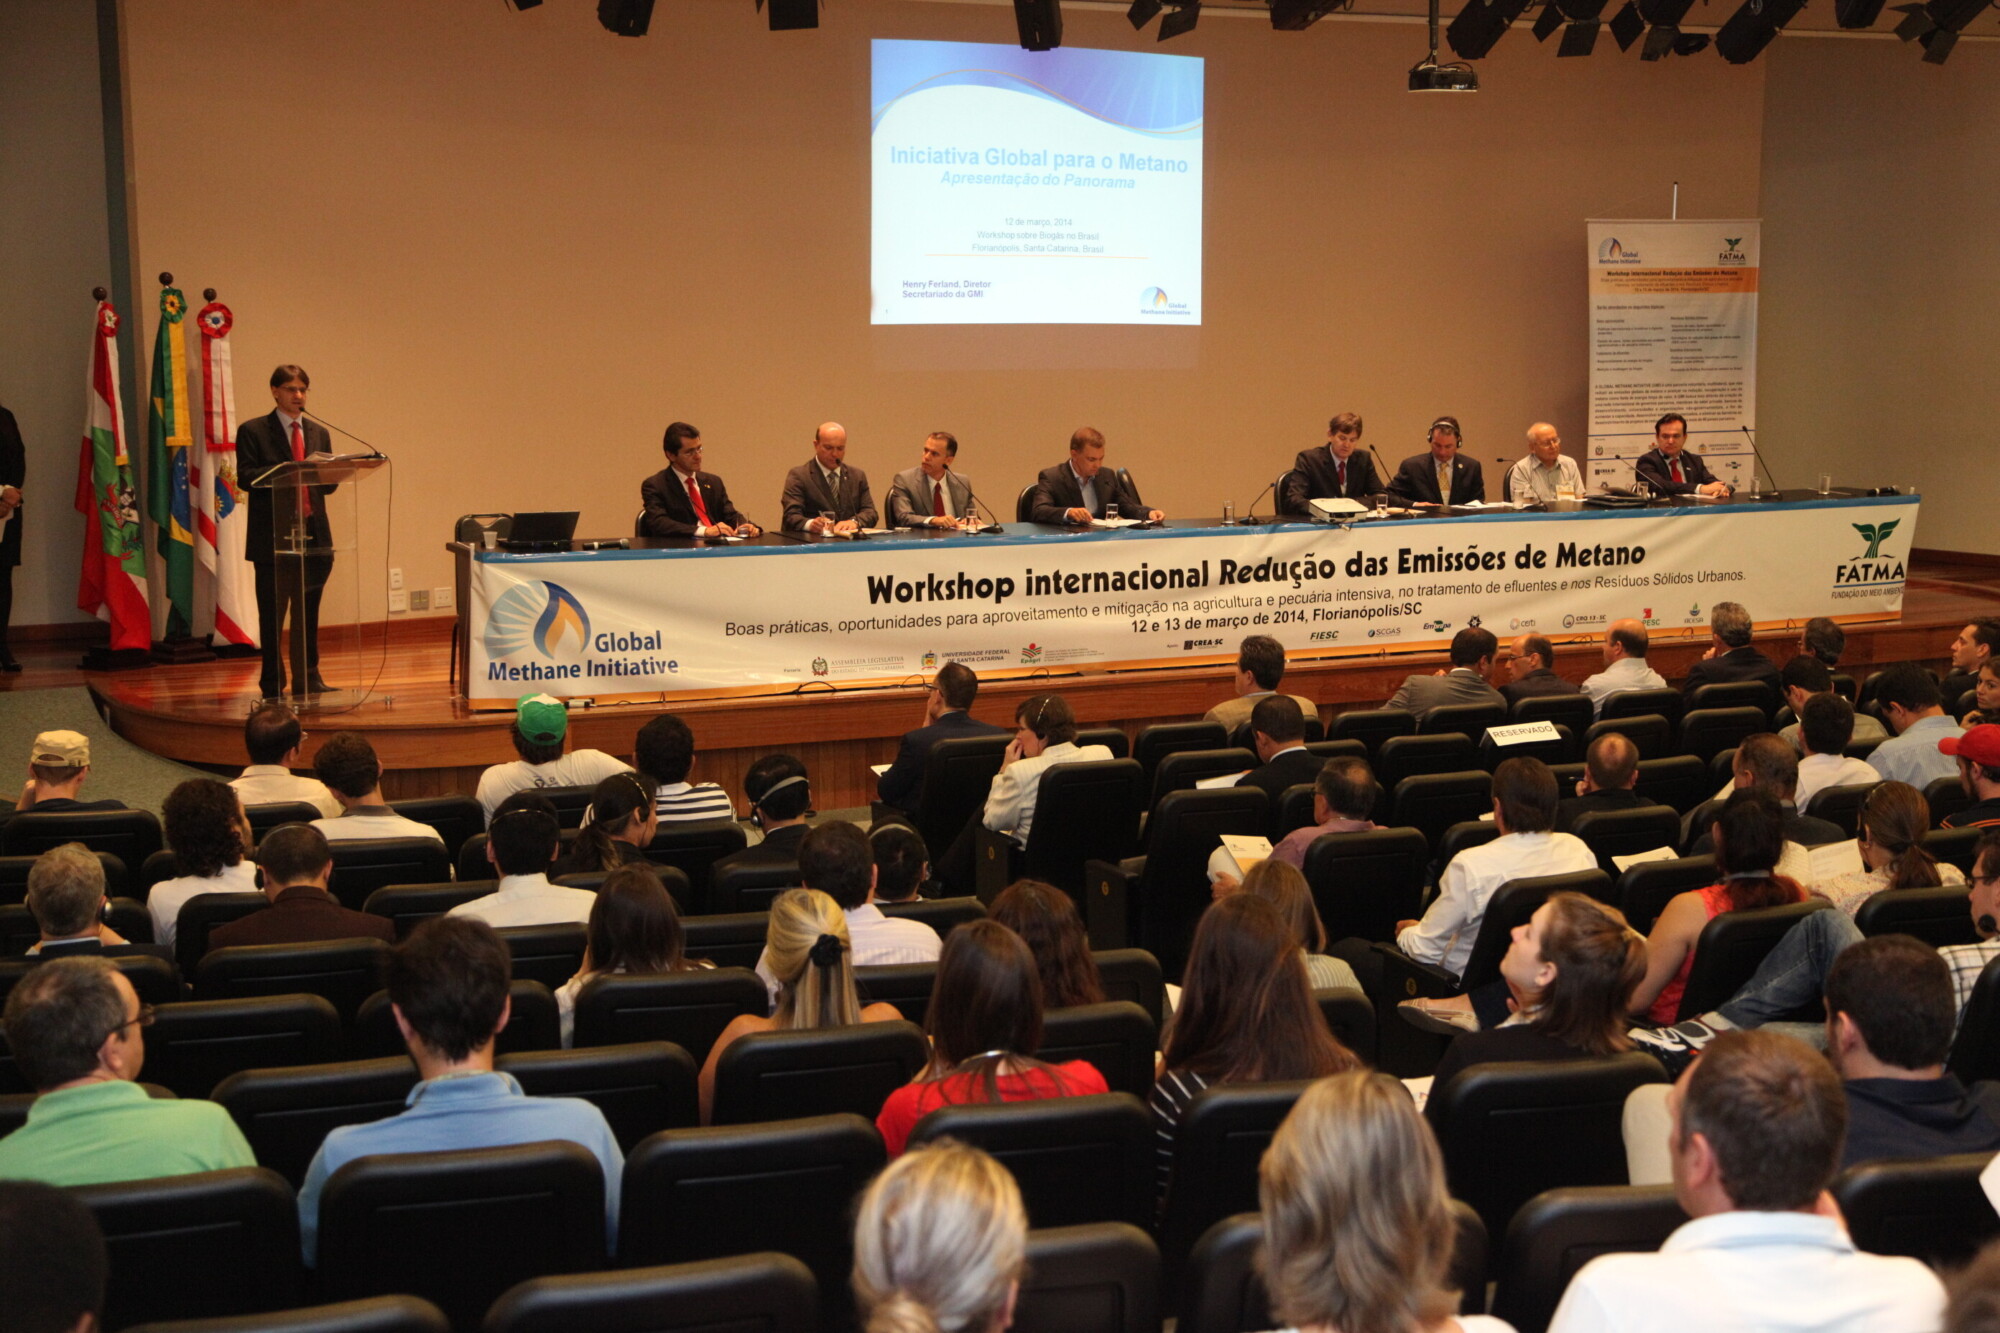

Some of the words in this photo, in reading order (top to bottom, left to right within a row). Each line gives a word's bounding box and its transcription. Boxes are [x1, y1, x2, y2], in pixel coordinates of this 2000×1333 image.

[891, 146, 980, 165] Iniciativa
[985, 148, 1047, 167] Global
[1053, 152, 1095, 171] para
[1101, 155, 1113, 169] o
[1119, 152, 1188, 173] Metano
[941, 170, 1039, 188] Apresentação
[1042, 172, 1060, 186] do
[1064, 173, 1136, 189] Panorama
[1005, 218, 1014, 226] 12
[1015, 218, 1024, 226] de
[1053, 218, 1073, 226] 2014
[977, 231, 1015, 241] Workshop
[1016, 231, 1037, 240] sobre
[1066, 232, 1076, 240] no
[1077, 231, 1100, 240] Brasil
[1023, 243, 1045, 253] Santa
[1082, 245, 1104, 254] Brasil
[1719, 252, 1746, 261] FATMA
[902, 280, 927, 289] Henry
[928, 280, 961, 289] Ferland,
[963, 280, 992, 288] Diretor
[902, 290, 953, 298] Secretariado
[955, 290, 965, 298] da
[967, 290, 984, 298] GMI
[867, 571, 1015, 604] Workshop
[1025, 559, 1209, 596] internacional
[1219, 552, 1336, 588] Redução
[1345, 551, 1388, 577] das
[1397, 544, 1506, 575] Emissões
[1514, 544, 1547, 569] de
[1555, 542, 1646, 568] Metano
[1836, 561, 1906, 583] FATMA
[1831, 588, 1860, 600] FUNDAÇÃO
[1860, 589, 1868, 597] DO
[1869, 588, 1882, 597] MEIO
[725, 621, 764, 636] Boas
[769, 619, 833, 637] práticas,
[838, 614, 942, 634] oportunidades
[946, 612, 978, 629] para
[982, 604, 1087, 626] aproveitamento
[1092, 606, 1100, 617] e
[1104, 600, 1168, 619] mitigação
[1172, 601, 1189, 612] na
[1193, 592, 1263, 614] agricultura
[1266, 596, 1275, 606] e
[1278, 590, 1332, 609] pecuária
[1335, 587, 1394, 603] intensiva,
[1398, 586, 1414, 598] no
[1417, 583, 1482, 598] tratamento
[1486, 580, 1501, 593] de
[1504, 577, 1557, 593] efluentes
[1560, 581, 1568, 590] e
[1571, 579, 1591, 590] nos
[1594, 574, 1650, 588] Resíduos
[1653, 570, 1694, 586] Sólidos
[1697, 569, 1747, 583] Urbanos.
[1131, 620, 1147, 633] 12
[1151, 622, 1160, 631] e
[1164, 618, 1181, 631] 13
[1184, 617, 1202, 630] de
[1205, 616, 1249, 630] março
[1253, 611, 1269, 625] de
[1273, 609, 1309, 625] 2014,
[1313, 602, 1423, 622] Florianópolis/SC
[595, 629, 662, 653] Global
[1310, 630, 1340, 640] FIESC
[941, 650, 984, 658] UNIVERSIDADE
[488, 661, 581, 681] Methane
[587, 656, 679, 677] Initiative
[1492, 725, 1553, 738] RESERVADO
